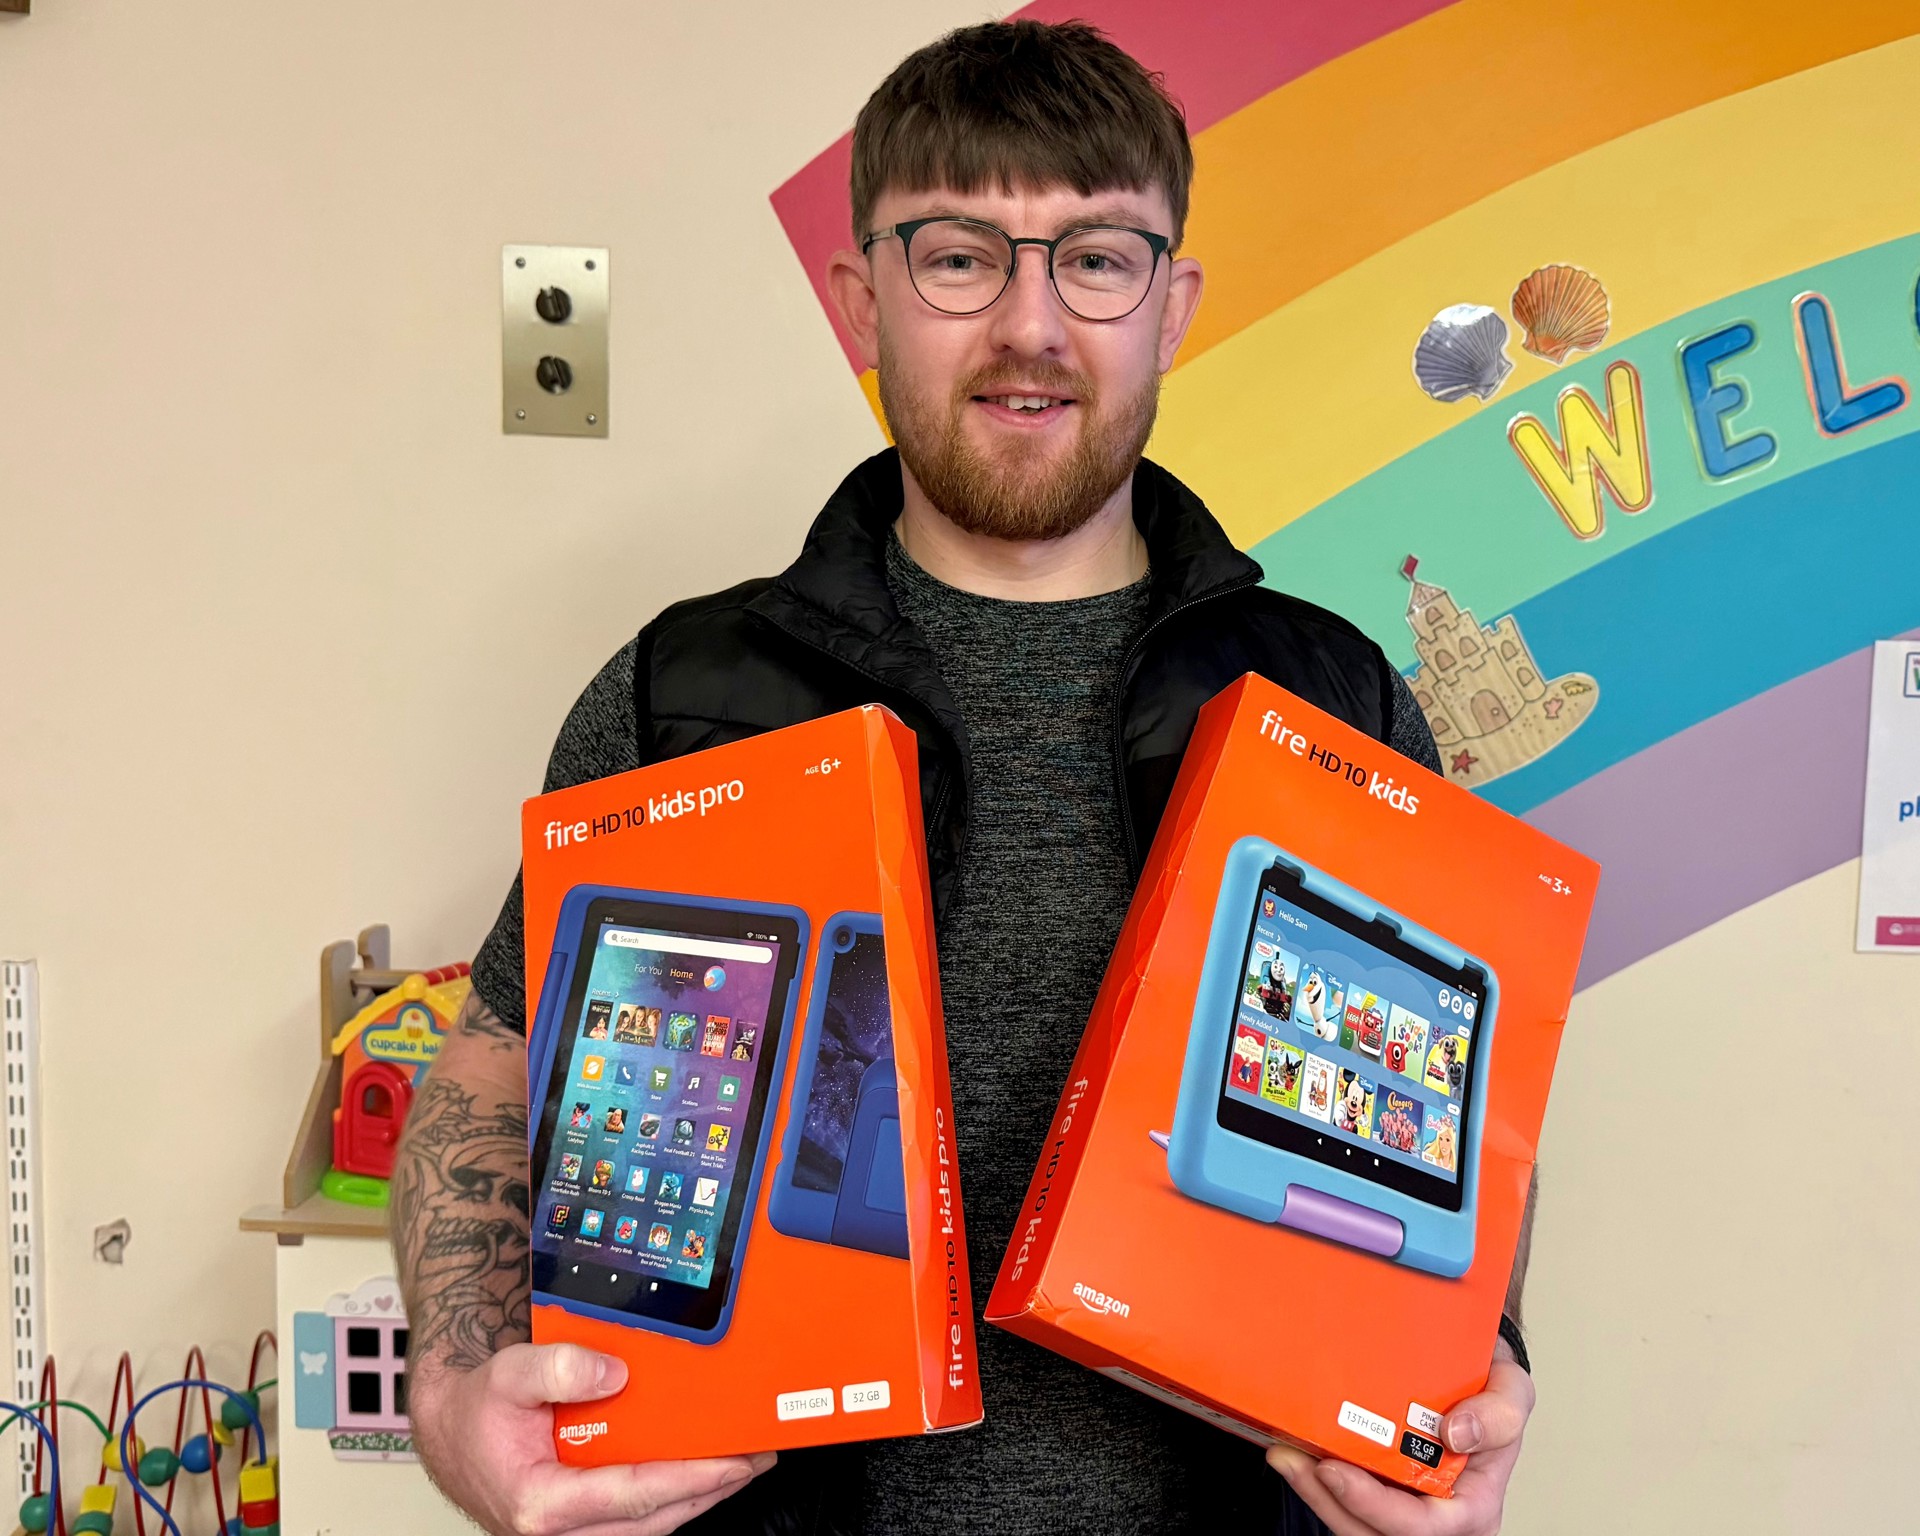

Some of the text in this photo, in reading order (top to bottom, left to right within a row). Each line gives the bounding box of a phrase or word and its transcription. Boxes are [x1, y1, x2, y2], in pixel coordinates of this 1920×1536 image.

[1507, 268, 1920, 540] WEL
[805, 758, 842, 776] AGE 6+
[1260, 710, 1307, 756] fire
[1368, 771, 1420, 815] kids
[544, 821, 588, 850] fire
[648, 790, 695, 824] kids
[699, 779, 744, 817] pro
[1552, 877, 1572, 896] 3+
[1279, 910, 1308, 931] Hello Sam
[620, 935, 639, 944] Search
[755, 933, 768, 941] 100%
[1257, 924, 1274, 939] Recent
[634, 963, 663, 976] For You
[669, 968, 694, 979] Home
[1240, 1012, 1273, 1032] Newly Added
[1346, 1012, 1359, 1023] LEGO
[371, 1038, 417, 1053] cupcake
[1059, 1076, 1089, 1135] fire
[935, 1107, 950, 1166] pro
[938, 1170, 954, 1234] kids
[658, 1208, 675, 1216] Legends
[610, 1245, 622, 1254] Angry
[1011, 1217, 1042, 1282] kids
[1073, 1282, 1130, 1318] amazon
[949, 1324, 964, 1390] fire
[784, 1397, 828, 1412] 13TH GEN
[853, 1390, 880, 1403] 32 GB
[1347, 1411, 1389, 1437] 13TH GEN
[1419, 1420, 1436, 1432] CASE
[1421, 1411, 1438, 1424] PINK
[559, 1421, 608, 1442] amazon
[1410, 1437, 1435, 1456] 32 GB
[1411, 1448, 1431, 1462] TABLET
